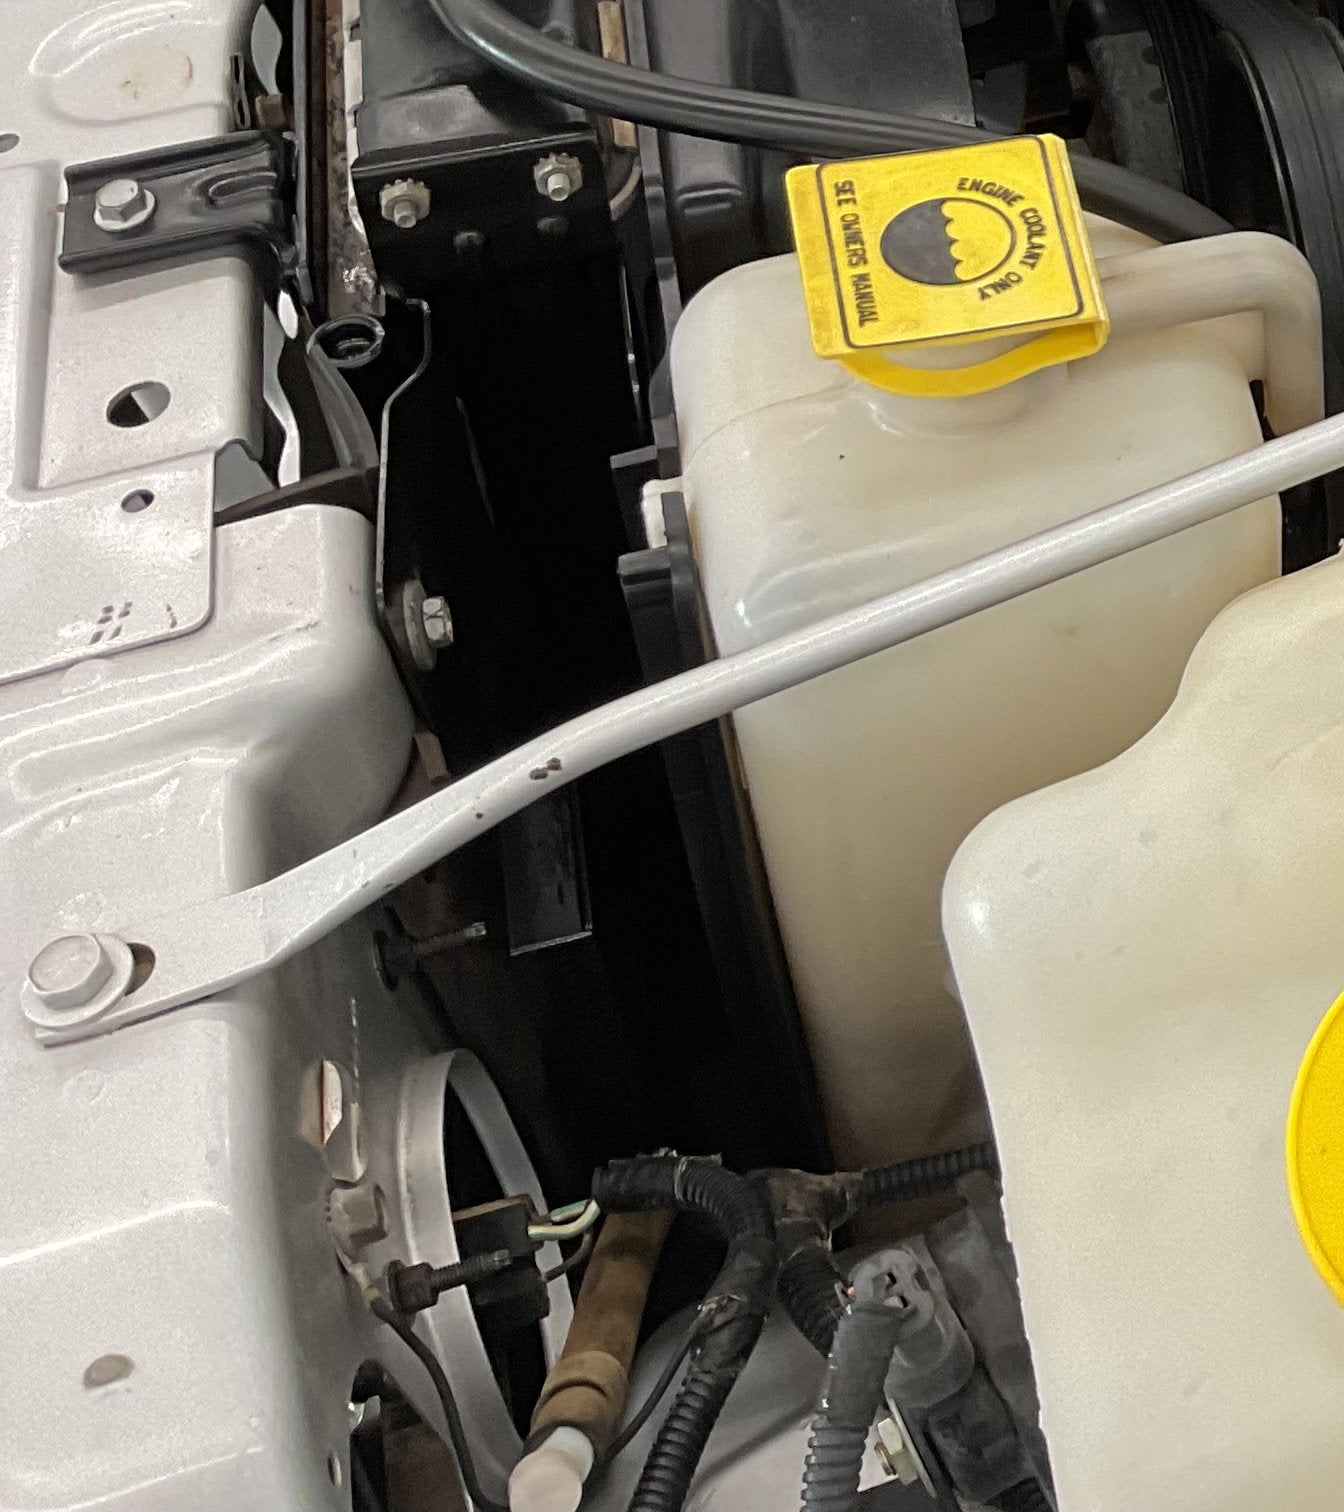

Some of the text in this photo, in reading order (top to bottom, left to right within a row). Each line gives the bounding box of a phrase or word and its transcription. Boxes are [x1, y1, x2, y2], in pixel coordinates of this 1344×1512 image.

[833, 180, 879, 328] SEE OWNERS MANUAL
[957, 177, 1048, 301] ENGINE COOLANT ONLY
